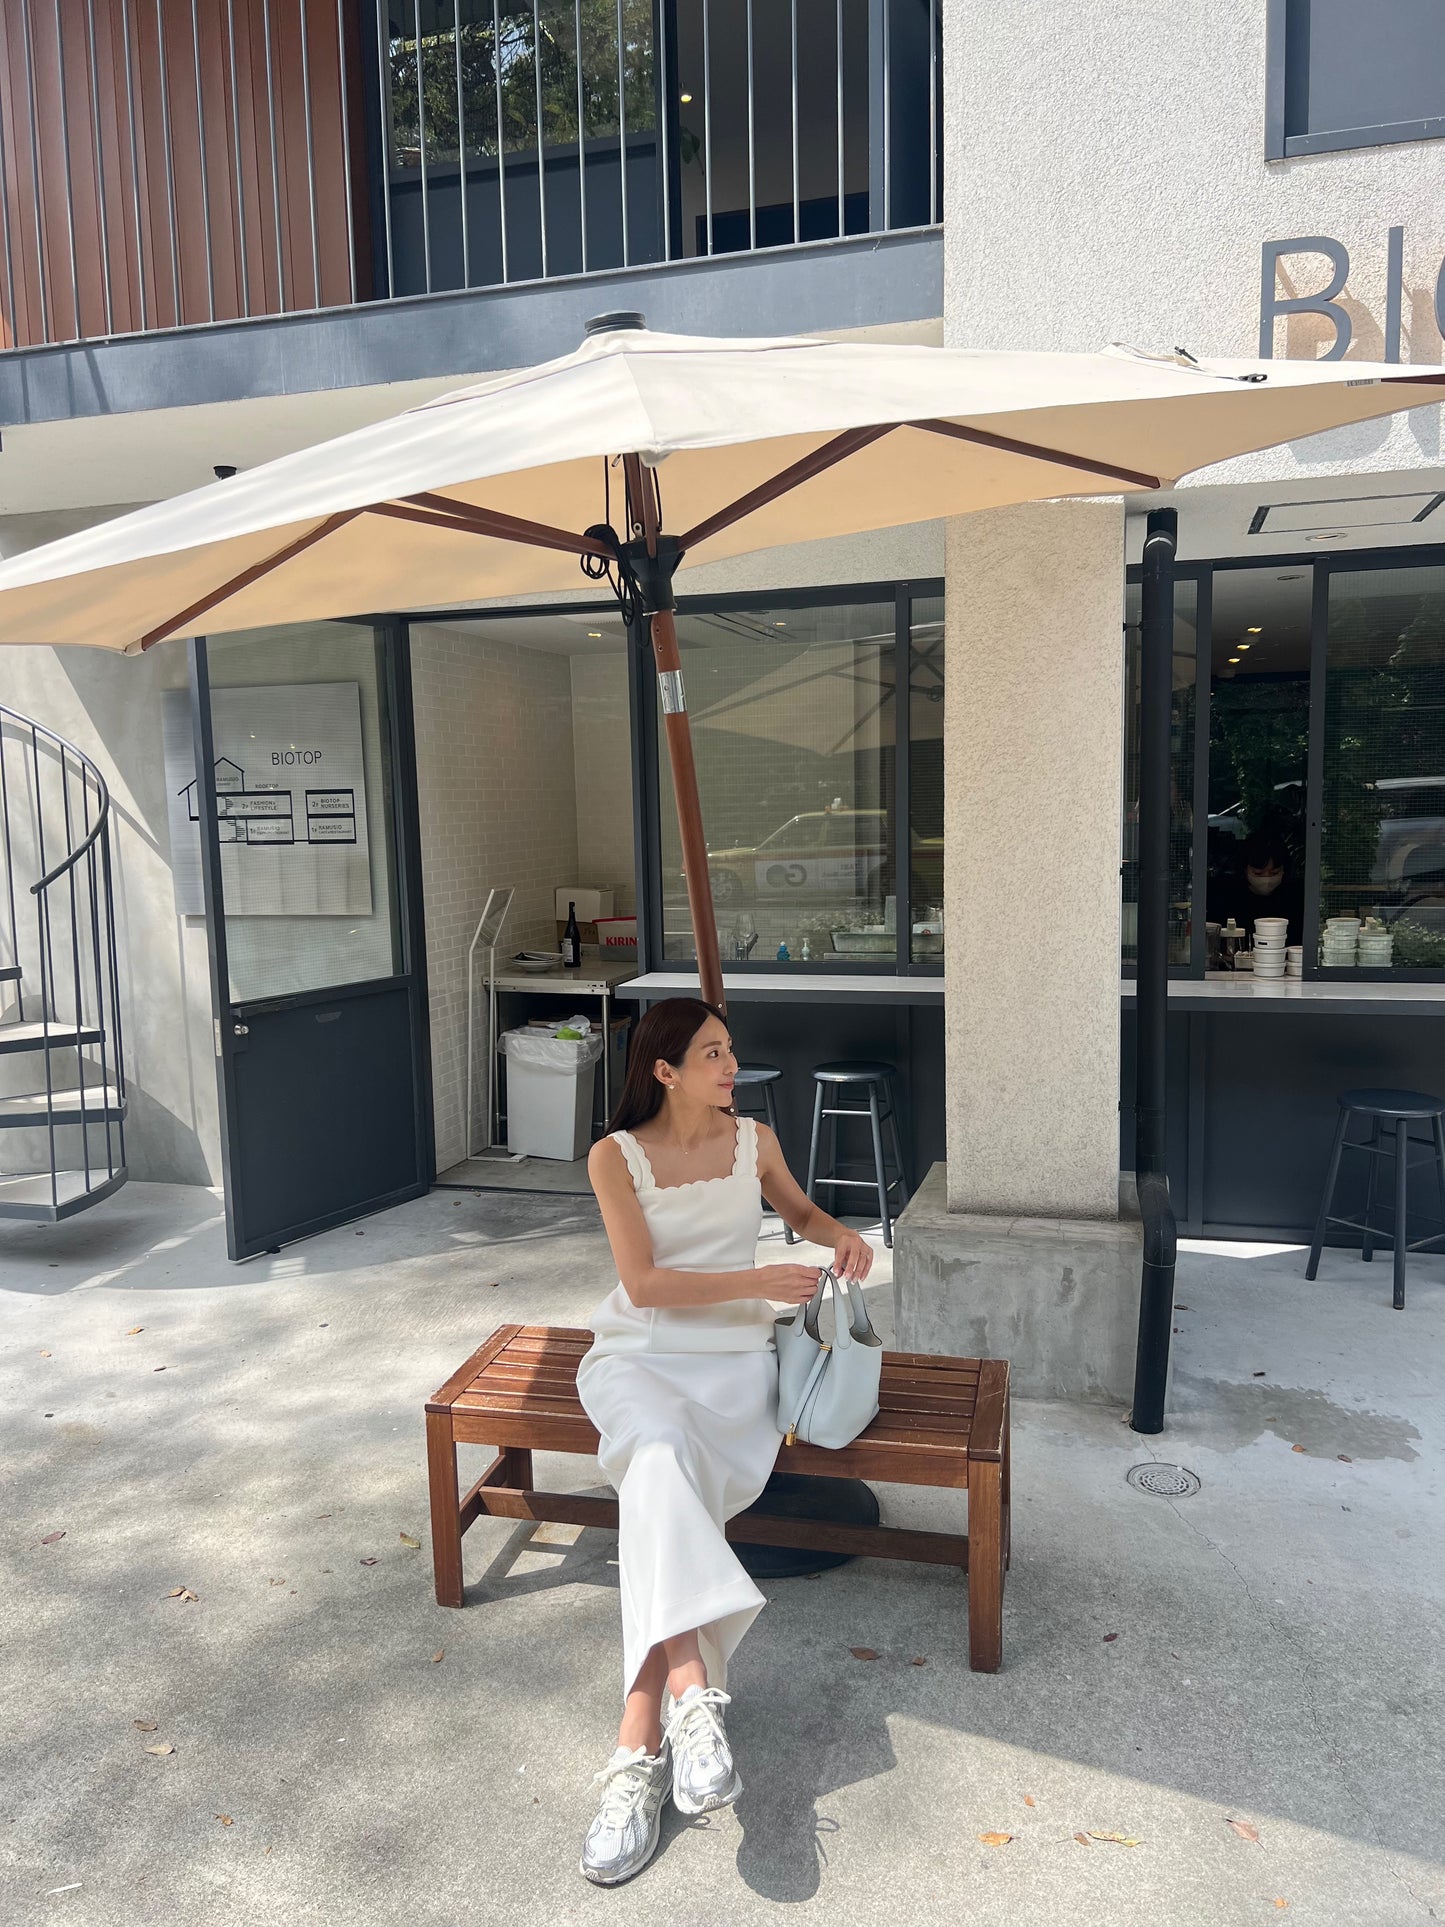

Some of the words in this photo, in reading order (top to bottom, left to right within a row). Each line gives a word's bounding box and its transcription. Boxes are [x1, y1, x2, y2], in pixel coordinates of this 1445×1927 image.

[1259, 226, 1445, 363] BI
[271, 750, 322, 765] BIOTOP
[605, 936, 638, 946] KIRIN
